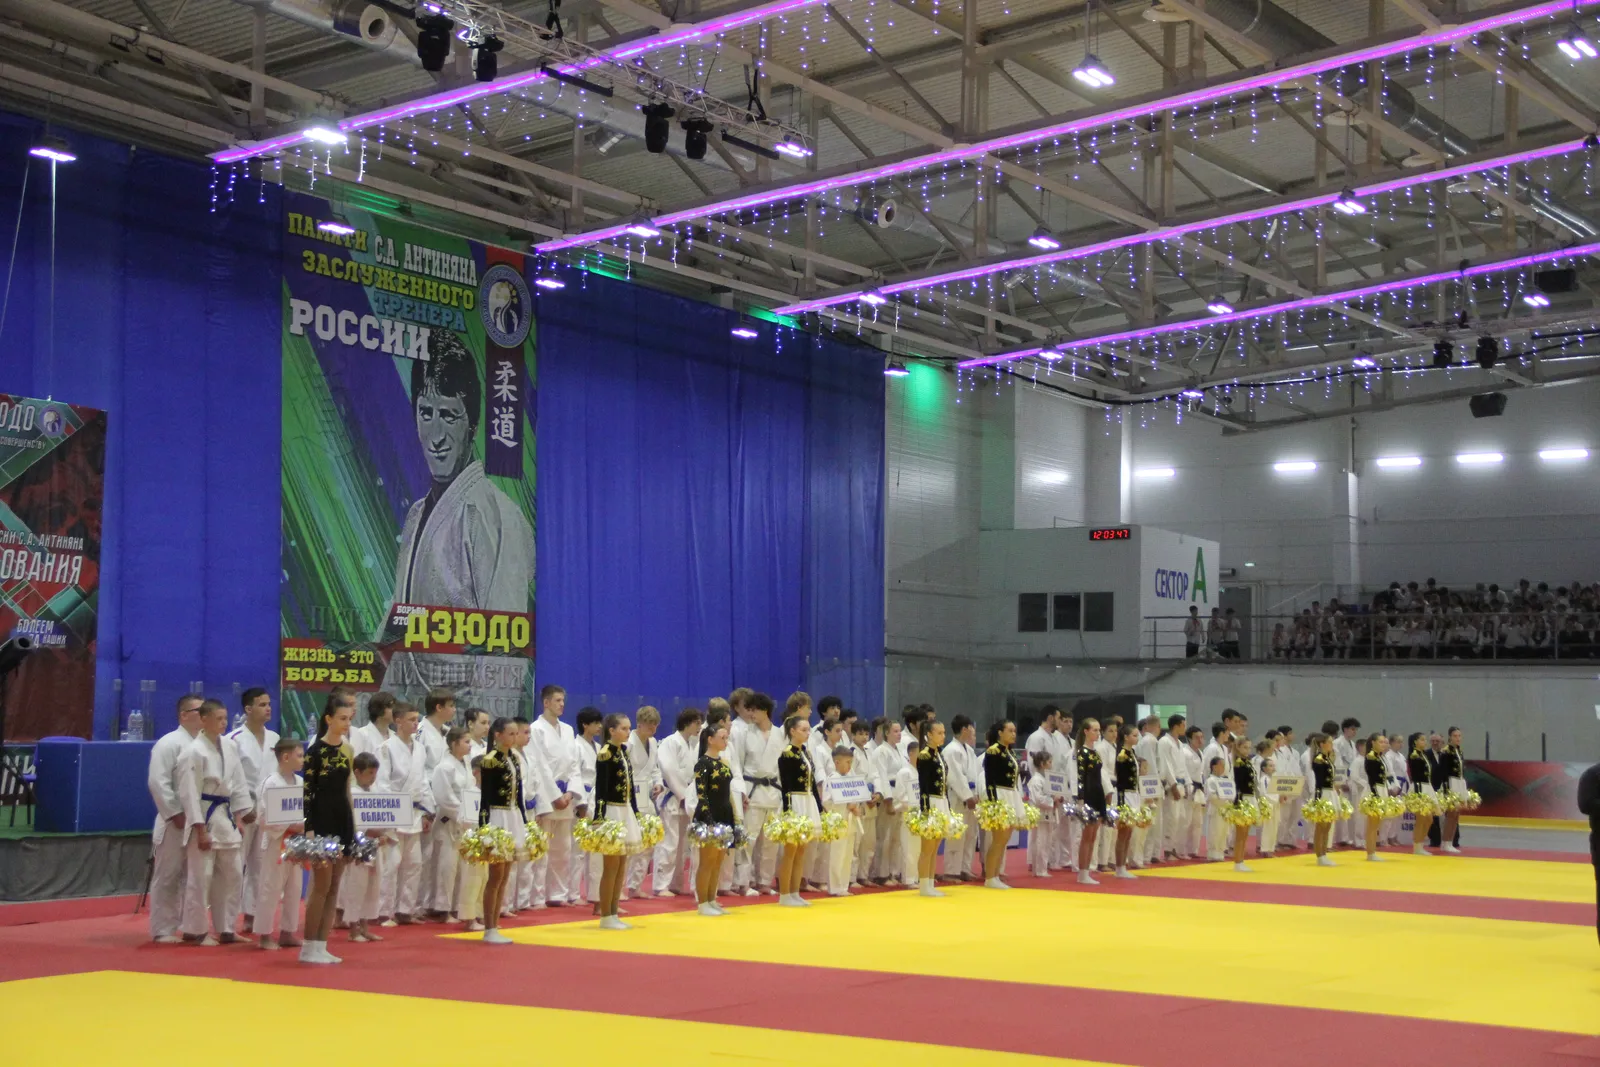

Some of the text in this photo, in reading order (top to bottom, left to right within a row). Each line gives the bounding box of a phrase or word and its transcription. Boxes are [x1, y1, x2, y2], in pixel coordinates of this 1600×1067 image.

[302, 250, 475, 310] ЗАСЛУЖЕННОГО
[403, 242, 478, 287] АНТИНЯНА
[289, 298, 431, 361] РОССИИ
[374, 291, 467, 333] ТРЕНЕРА
[491, 360, 519, 448] 柔道
[1155, 547, 1207, 603] СЕКТОР А
[17, 619, 54, 634] БОЛЕЕМ
[392, 616, 408, 625] ЭТО
[405, 609, 530, 653] ДЗЮДО
[283, 647, 336, 663] ЖИЗНЬ
[350, 650, 375, 665] ЭТО
[285, 667, 375, 684] БОРЬБА
[353, 798, 401, 809] ПЕНЗЕНСКАЯ
[361, 811, 396, 822] ОБЛАСТЬ
